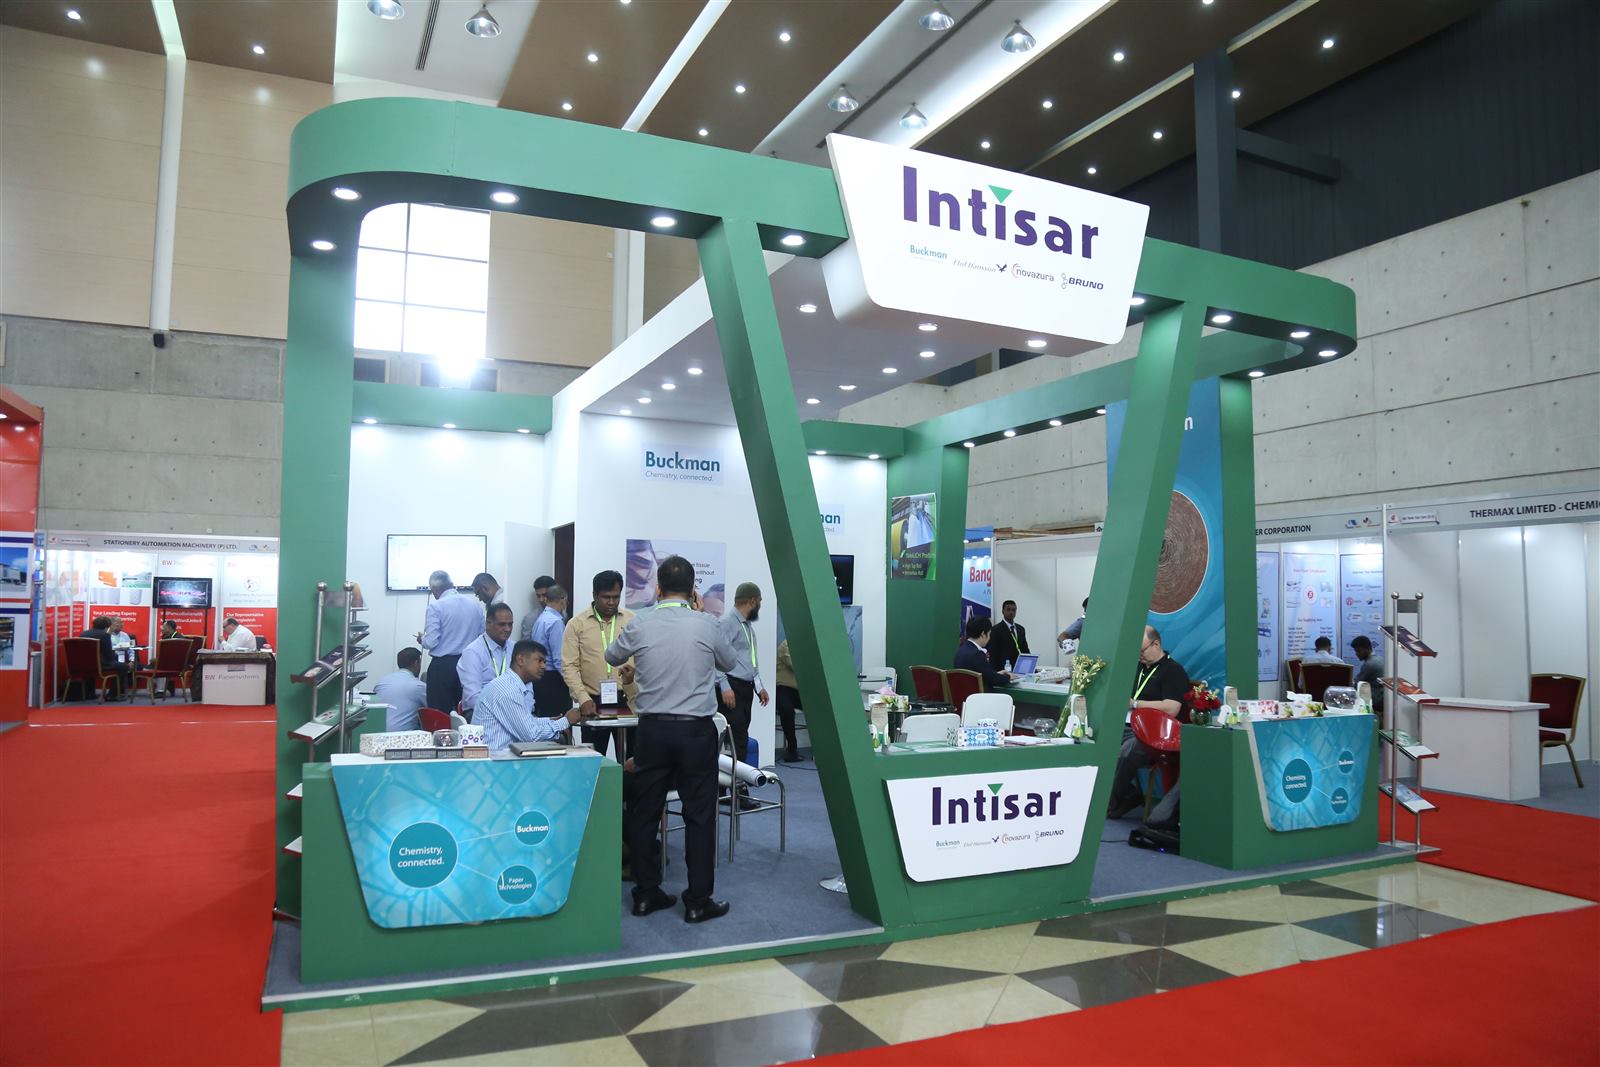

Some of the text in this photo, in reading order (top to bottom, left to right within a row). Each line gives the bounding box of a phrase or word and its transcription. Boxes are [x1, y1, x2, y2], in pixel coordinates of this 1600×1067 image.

[903, 165, 1099, 259] Intisar
[910, 244, 948, 260] Buckman
[1016, 267, 1055, 282] novazura
[1068, 277, 1104, 291] BRUNO
[645, 451, 721, 472] Buckman
[645, 470, 714, 482] Chemistry, connected.
[1470, 507, 1514, 518] THERMAX
[1516, 503, 1557, 515] LIMITED
[1264, 524, 1312, 535] CORPORATION
[141, 540, 181, 548] AUTOMATION
[932, 787, 1062, 826] Intisar
[517, 824, 549, 834] Buckman
[1040, 829, 1065, 839] BRUNO
[936, 839, 961, 848] Buckman
[399, 845, 443, 857] Chemistry,
[397, 857, 445, 868] connected.
